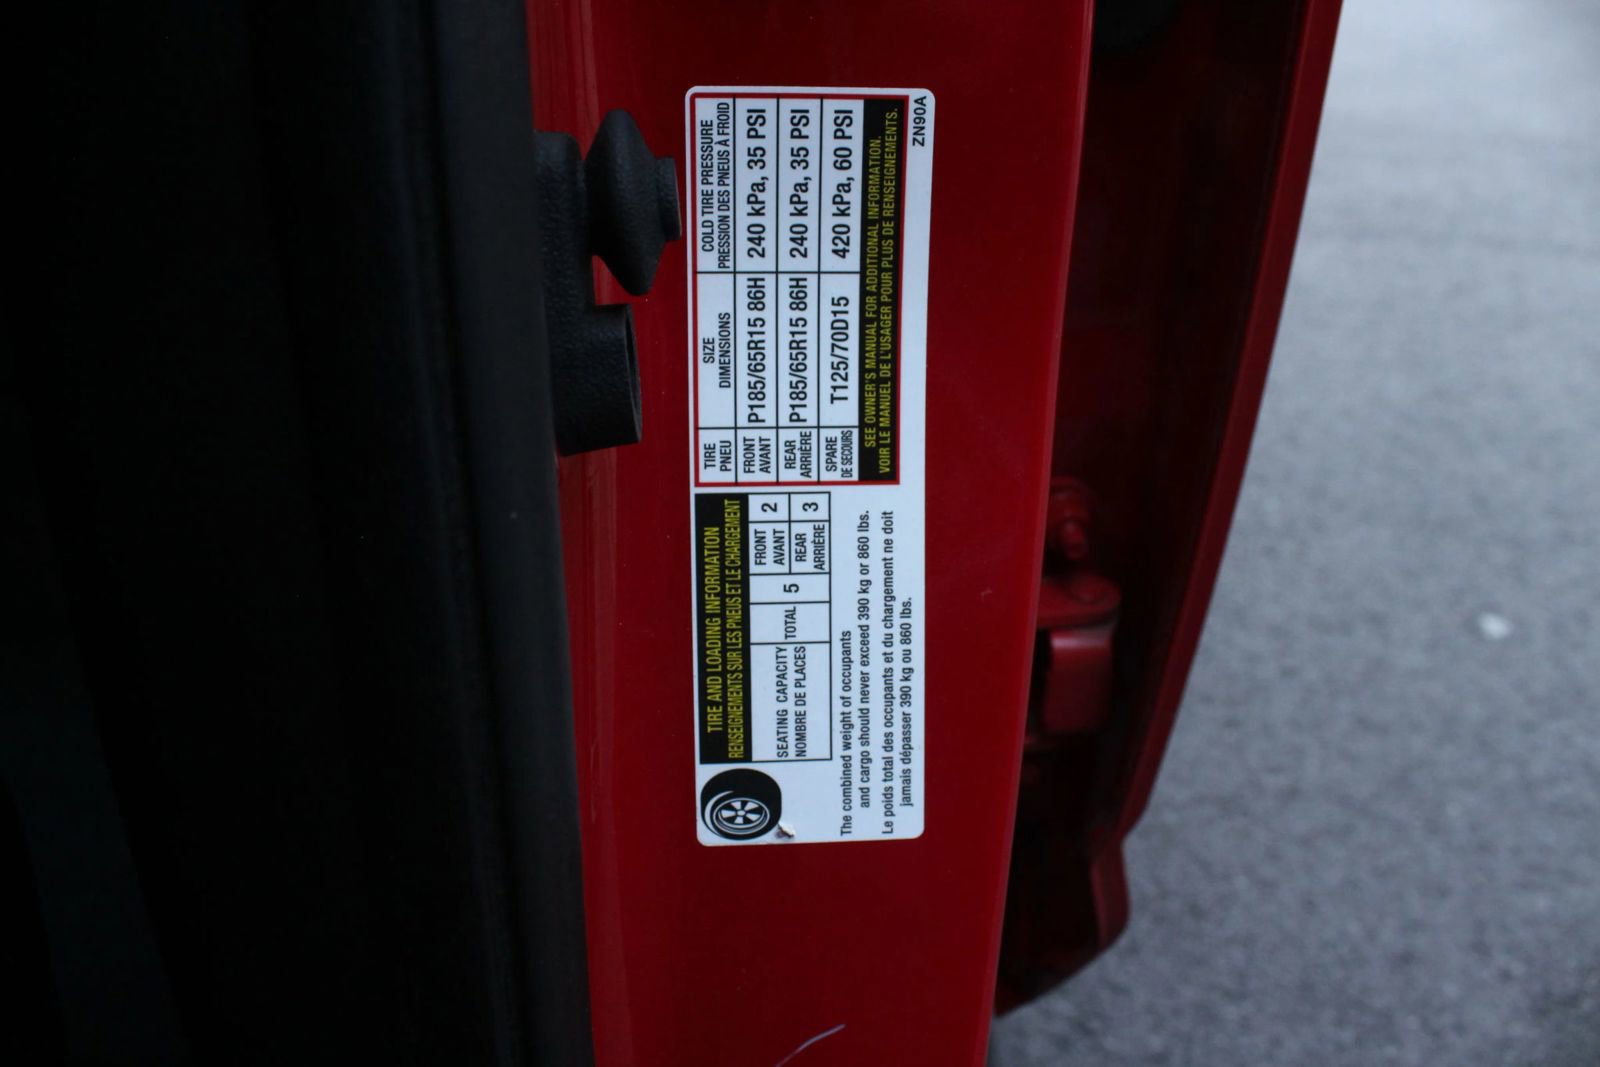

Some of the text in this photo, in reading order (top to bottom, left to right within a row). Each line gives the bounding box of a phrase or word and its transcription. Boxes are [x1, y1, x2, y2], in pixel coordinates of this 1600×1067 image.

[912, 96, 927, 147] ZN90A
[700, 120, 715, 252] COLD TIRE PRESSURE
[715, 102, 730, 269] PRESSION DES PNEUS À FROID
[746, 109, 769, 258] 240 kPa, 35 PSI
[789, 109, 812, 258] 240 kPa, 35 PSI
[832, 109, 855, 259] 420 kPa, 60 PSI
[864, 136, 881, 447] SEE OWNER'S MANUAL FOR ADDITIONAL INFORMATION.
[879, 109, 897, 473] VOIR LE MANUEL DE L'USAGER POUR PLUS DE RENSEIGNEMENTS.
[702, 337, 715, 364] SIZE
[718, 312, 731, 388] DIMENSIONS
[747, 277, 766, 423] P185/65R15 86H
[789, 277, 808, 423] P185/65R15 86H
[830, 296, 850, 404] T125/70D15
[704, 443, 716, 470] TIRE
[719, 440, 732, 472] PNEU
[743, 436, 755, 473] FRONT
[759, 436, 771, 474] AVANT
[784, 440, 796, 469] REAR
[797, 431, 812, 478] ARRIÈRE
[825, 436, 838, 472] SPARE
[841, 430, 853, 478] DE SECOURS
[761, 502, 777, 512] 2
[802, 502, 819, 512] 3
[754, 529, 767, 565] FRONT
[773, 528, 785, 565] AVANT
[795, 533, 807, 562] REAR
[811, 524, 825, 571] ARRIÈRE
[783, 583, 799, 593] 5
[784, 606, 797, 640] TOTAL
[704, 527, 722, 733] TIRE AND LOADING INFORMATION
[724, 499, 744, 758] RENSEIGNEMENTS SUR LES PNEUS ET LE CHARGEMENT
[857, 510, 872, 808] and cargo should never exceed 390 kg or 860 lbs.
[775, 646, 789, 758] SEATING CAPACITY
[794, 646, 807, 757] NOMBRE DE PLACES
[881, 511, 896, 834] Le poids total des occupants et du chargement ne doit
[899, 597, 914, 807] jamais dépasser 390 kg ou 860 lbs.
[839, 630, 855, 836] The combined weight of occupants
